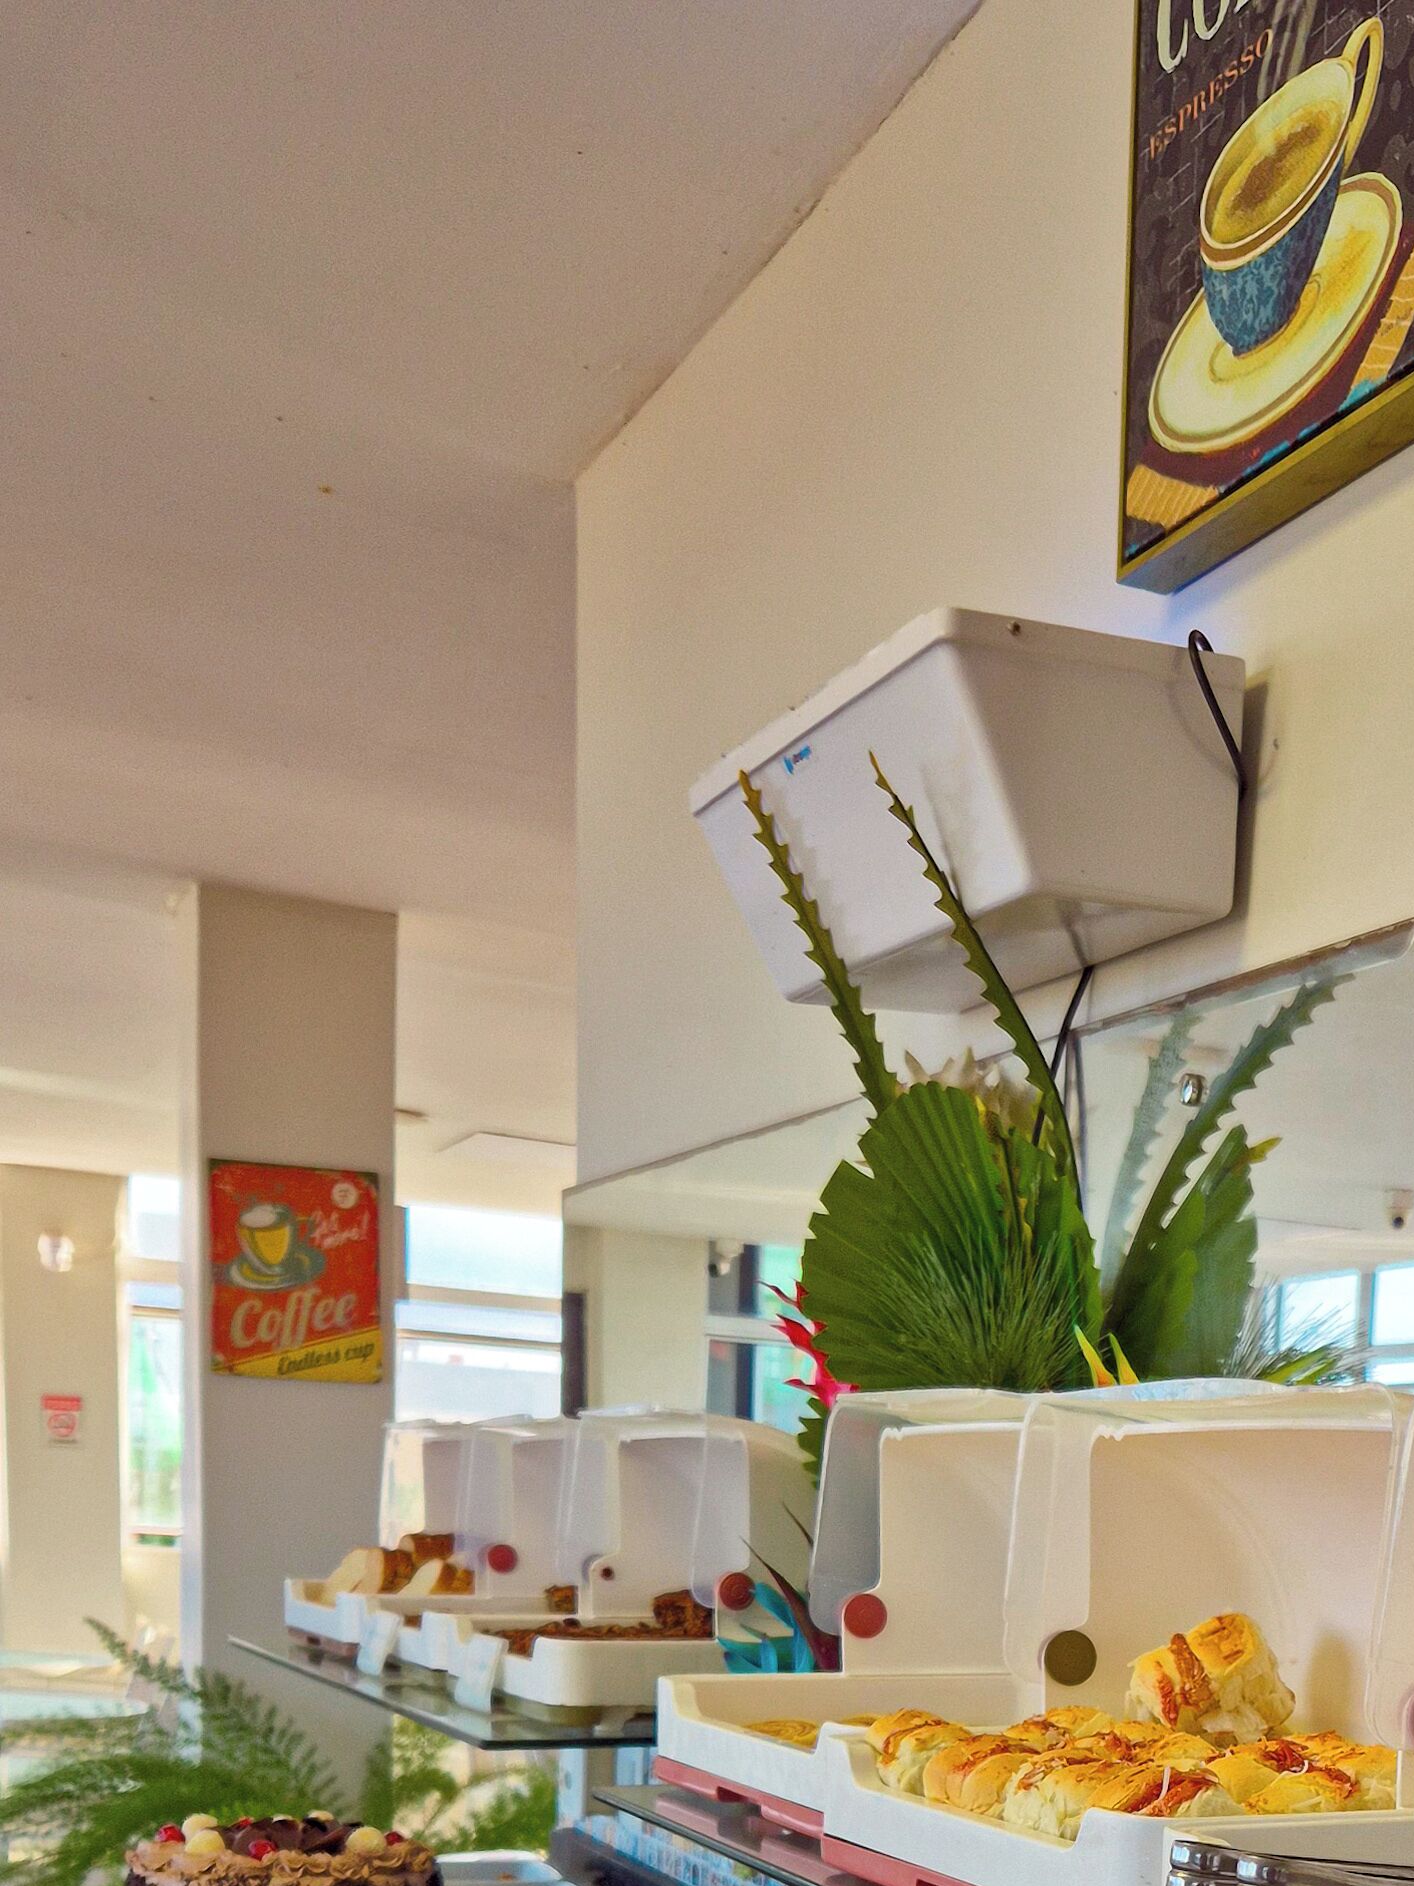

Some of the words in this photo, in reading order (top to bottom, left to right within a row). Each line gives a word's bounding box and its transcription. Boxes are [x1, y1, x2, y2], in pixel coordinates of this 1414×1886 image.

[1149, 28, 1273, 160] ESPRESSO
[231, 1288, 356, 1348] Coffee
[277, 1346, 341, 1376] Endless
[344, 1344, 376, 1363] cup
